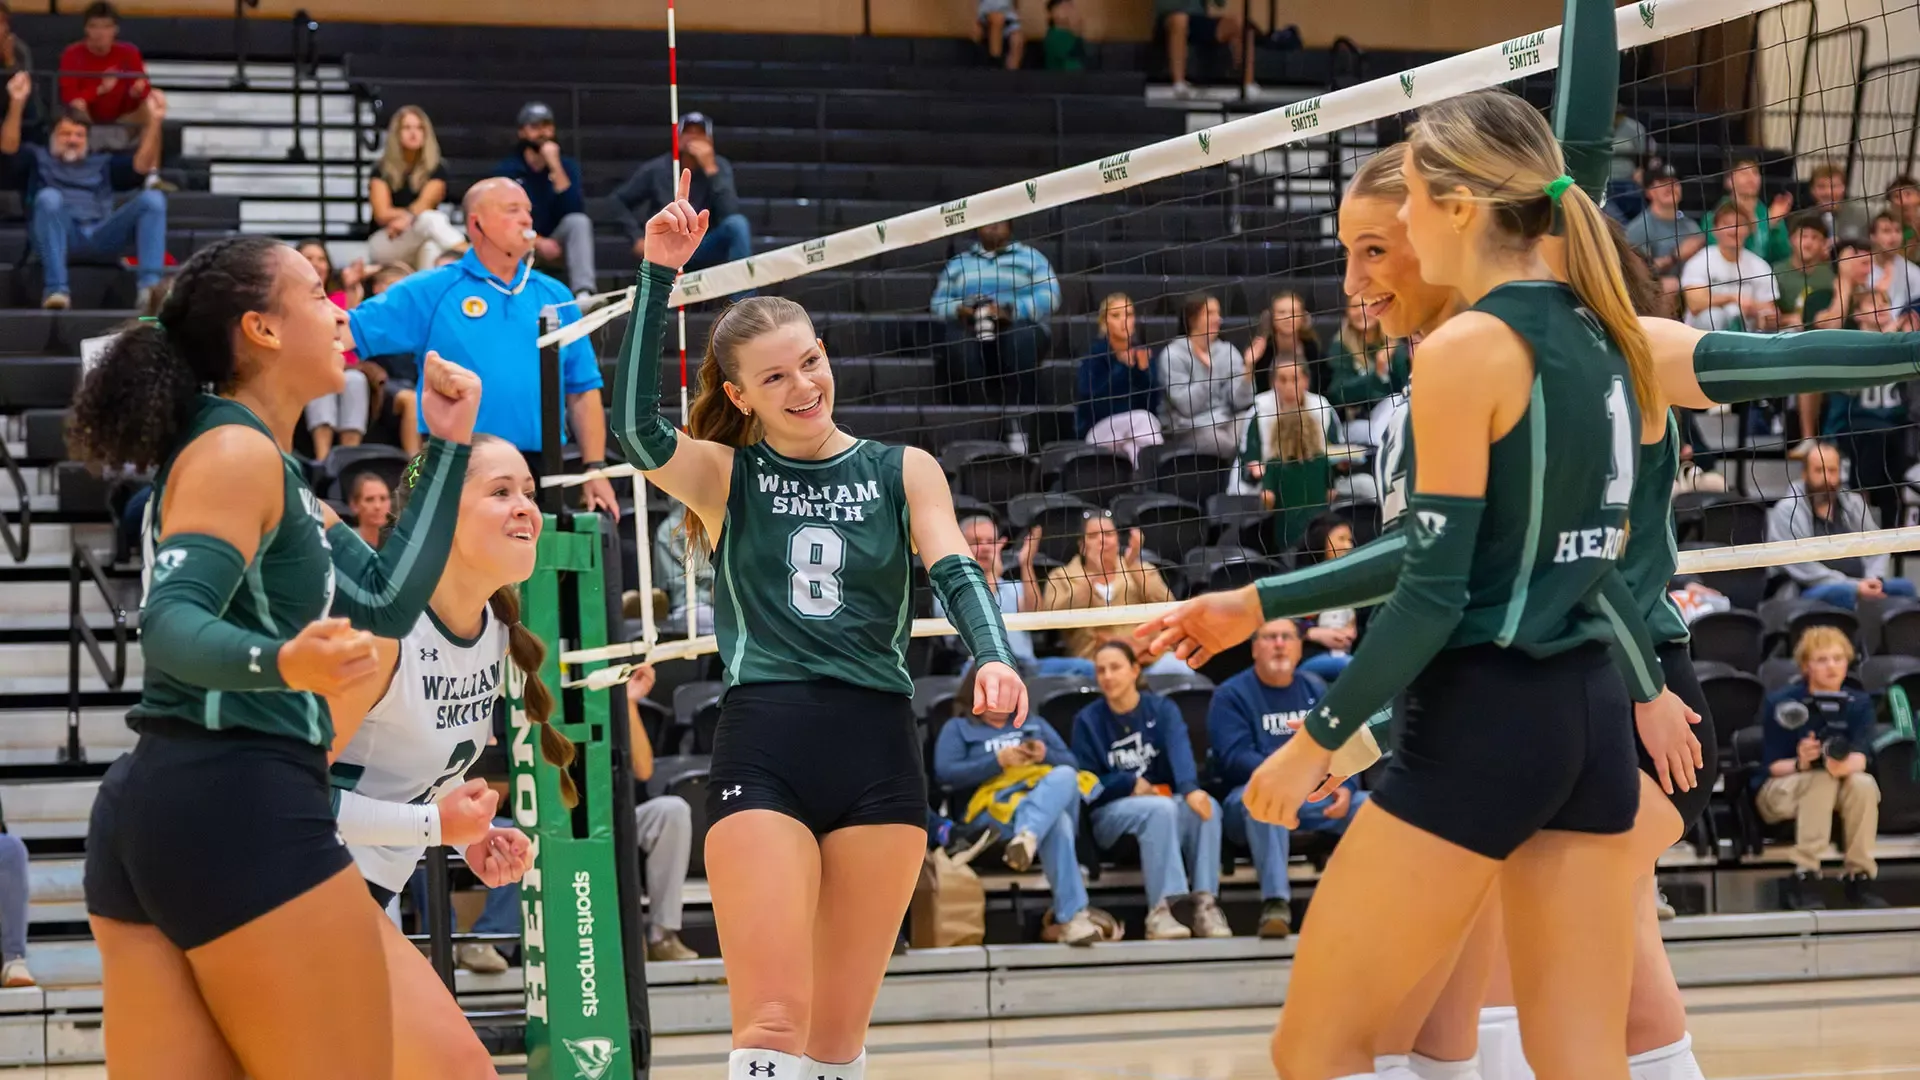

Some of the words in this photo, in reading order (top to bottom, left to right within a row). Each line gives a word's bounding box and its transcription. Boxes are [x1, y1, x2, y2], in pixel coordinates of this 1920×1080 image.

[1501, 32, 1545, 56] WILLIAM
[1509, 49, 1541, 71] SMITH
[1284, 97, 1321, 118] WILLIAM
[1291, 112, 1319, 132] SMITH
[1098, 152, 1131, 170] WILLIAM
[1103, 166, 1128, 183] SMITH
[1602, 375, 1633, 509] 1
[757, 473, 880, 503] WILLIAM
[772, 496, 864, 521] SMITH
[786, 522, 847, 620] 8
[422, 660, 500, 701] WILLIAM
[436, 694, 495, 730] SMITH
[572, 871, 594, 936] sports
[576, 938, 599, 1017] imports
